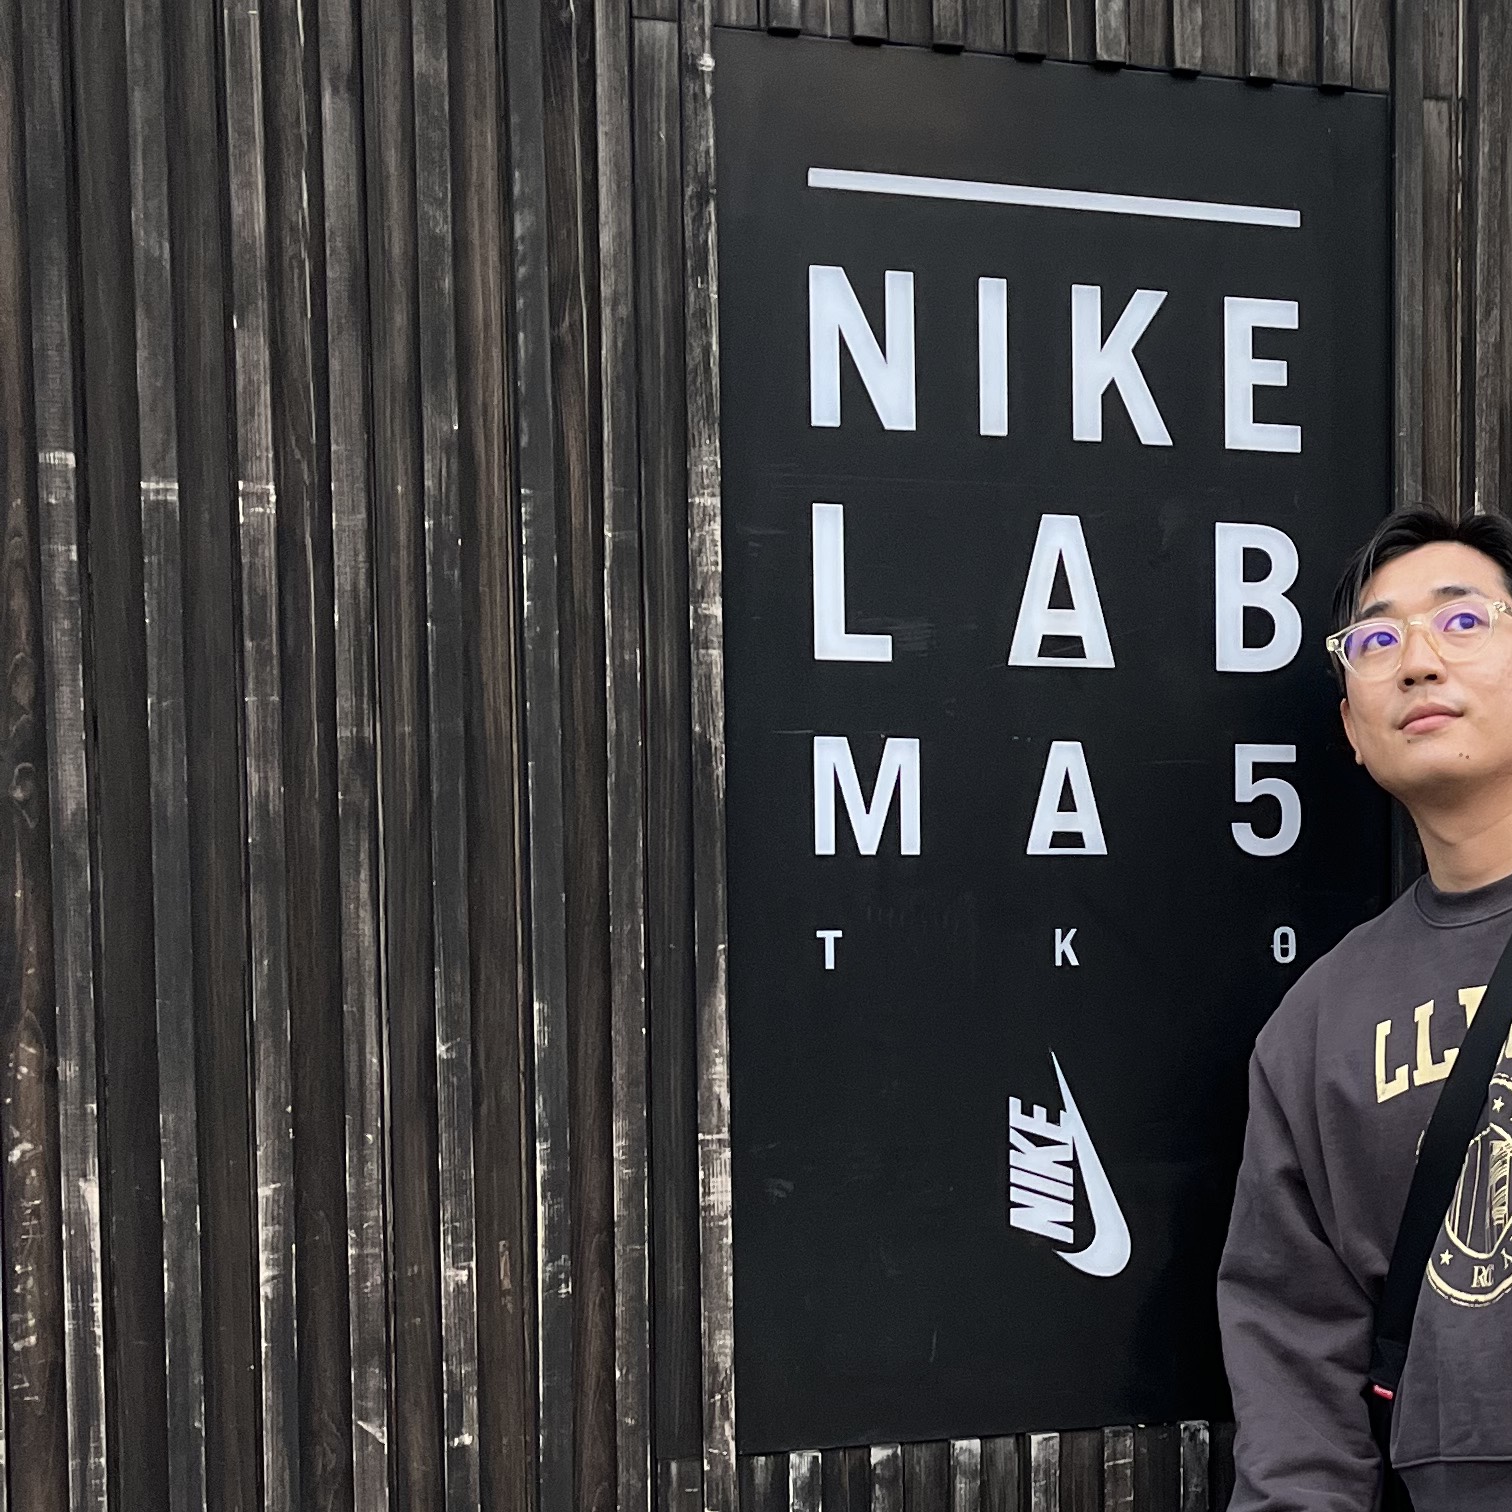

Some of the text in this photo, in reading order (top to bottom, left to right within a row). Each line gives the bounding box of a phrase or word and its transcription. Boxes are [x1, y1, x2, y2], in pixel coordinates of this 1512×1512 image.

[808, 265, 1303, 453] NIKE
[812, 503, 1303, 673] LAB
[813, 736, 1303, 857] MA5
[1008, 1095, 1074, 1244] NIKE
